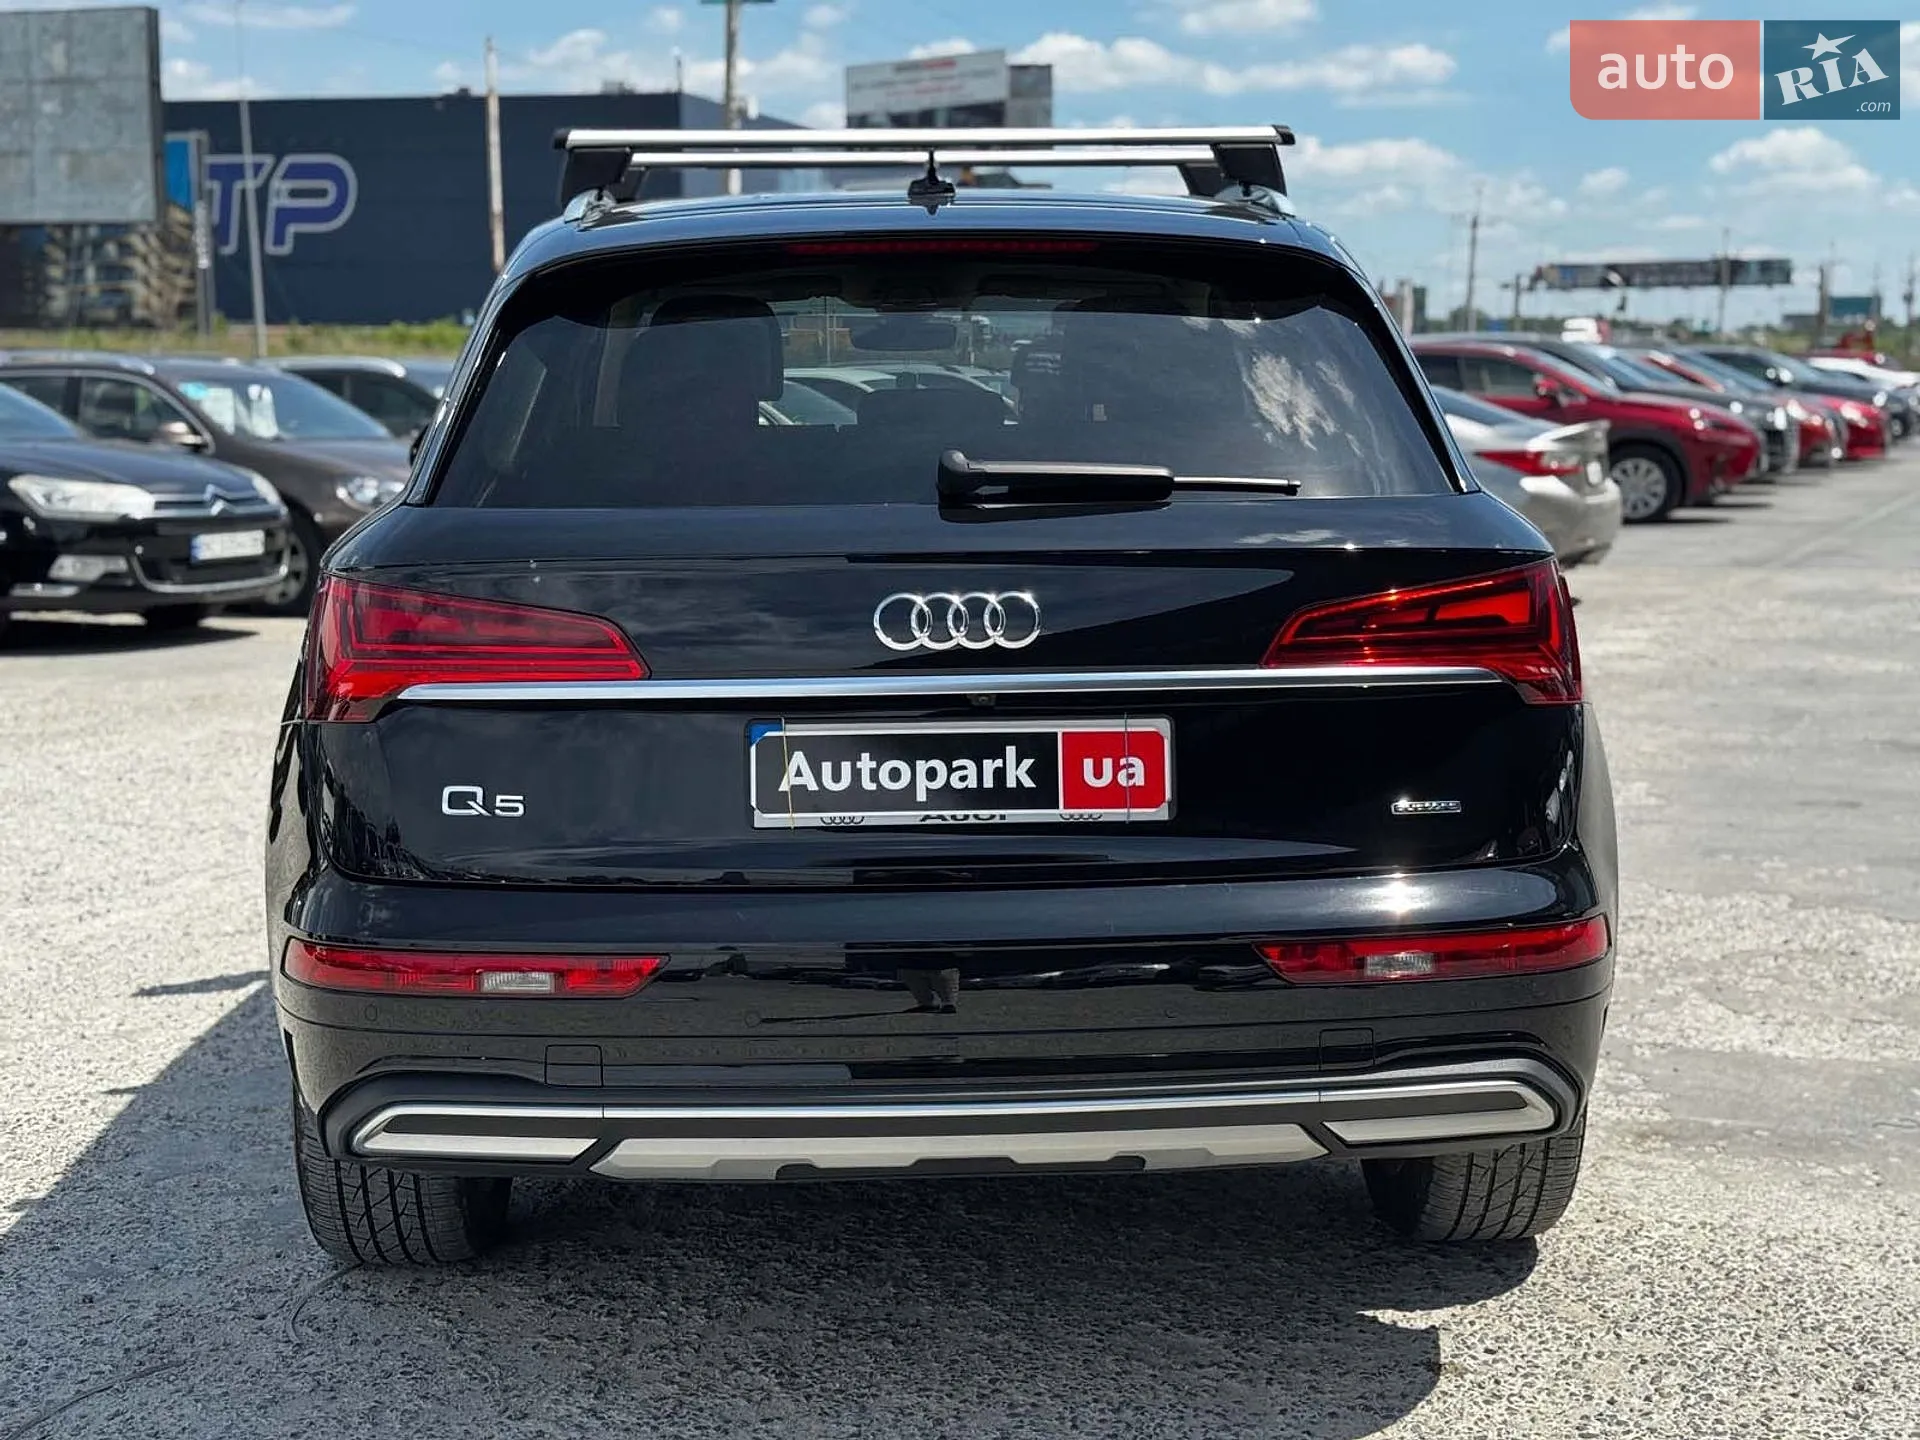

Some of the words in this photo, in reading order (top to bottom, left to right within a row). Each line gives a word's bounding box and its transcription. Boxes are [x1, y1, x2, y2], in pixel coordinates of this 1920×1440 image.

[778, 744, 1037, 801] Autopark
[1083, 756, 1146, 788] ua
[441, 785, 526, 818] Q5
